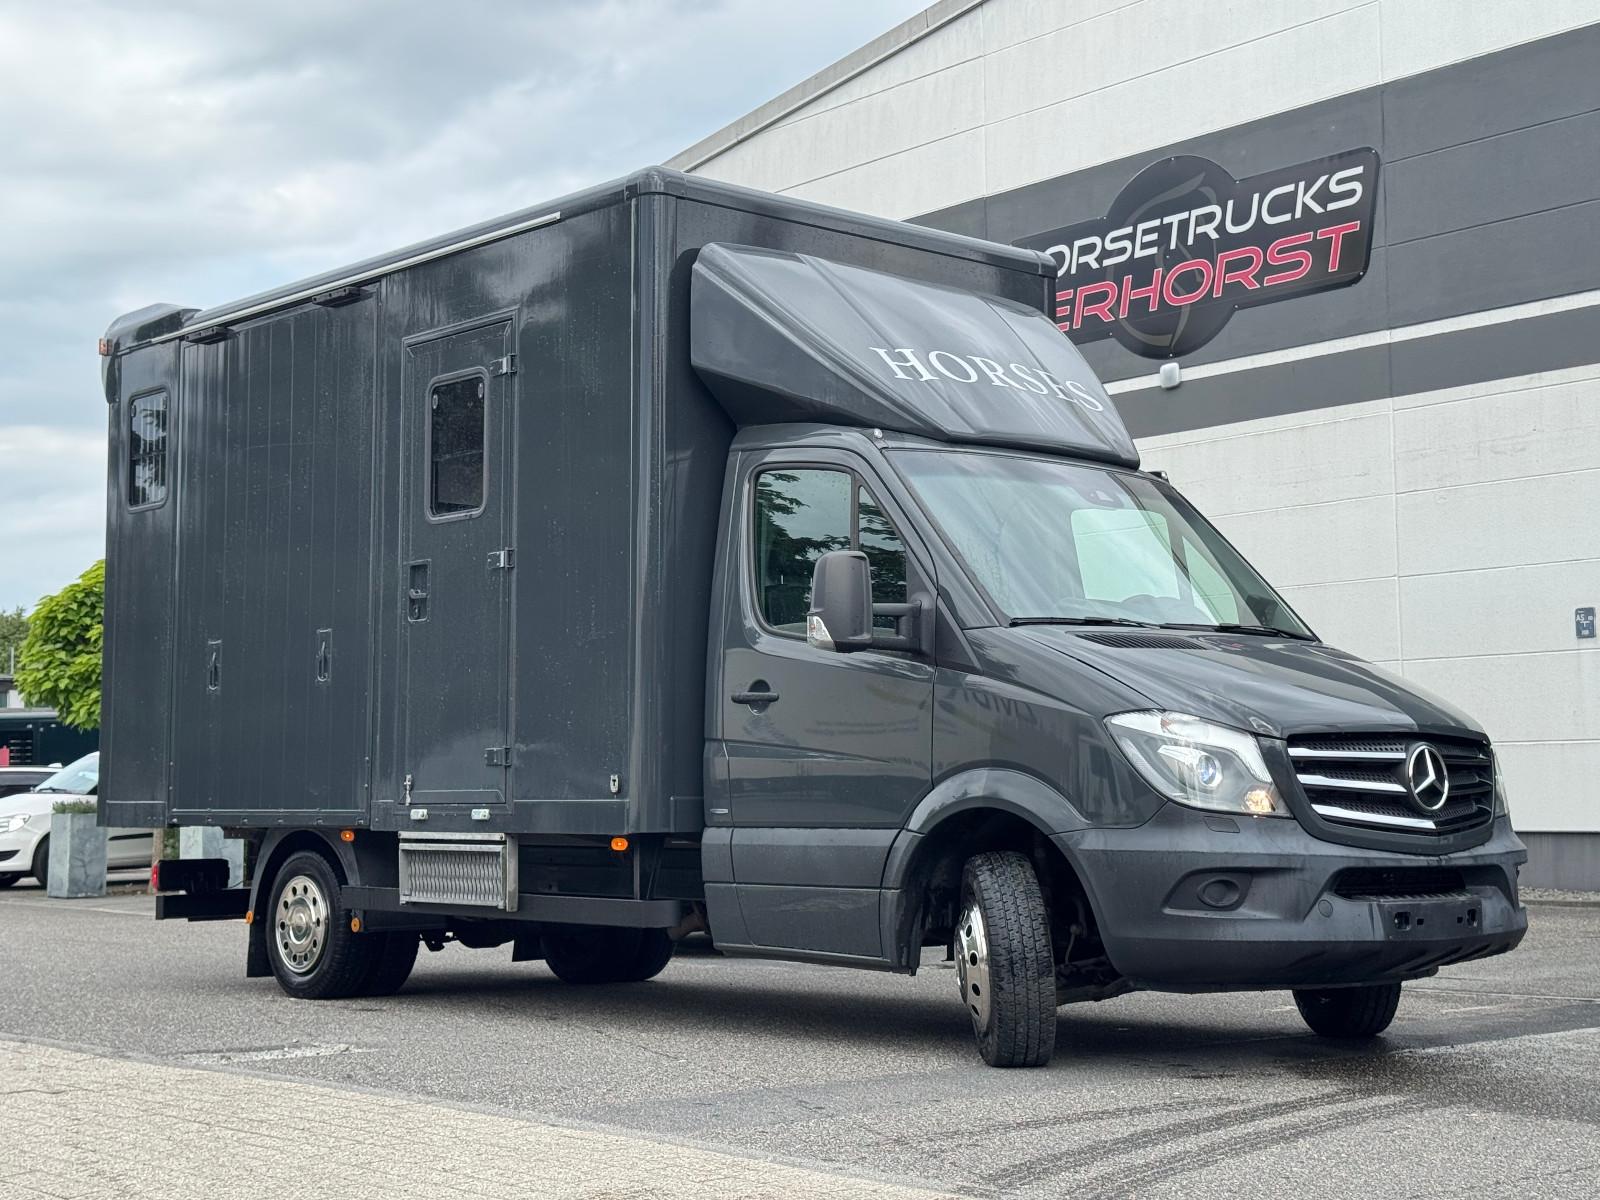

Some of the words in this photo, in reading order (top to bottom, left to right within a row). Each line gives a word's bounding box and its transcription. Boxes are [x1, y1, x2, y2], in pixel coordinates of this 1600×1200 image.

[1045, 166, 1364, 277] ORSETRUCKS
[1056, 221, 1360, 332] ERHORST
[869, 346, 1105, 412] HORSES
